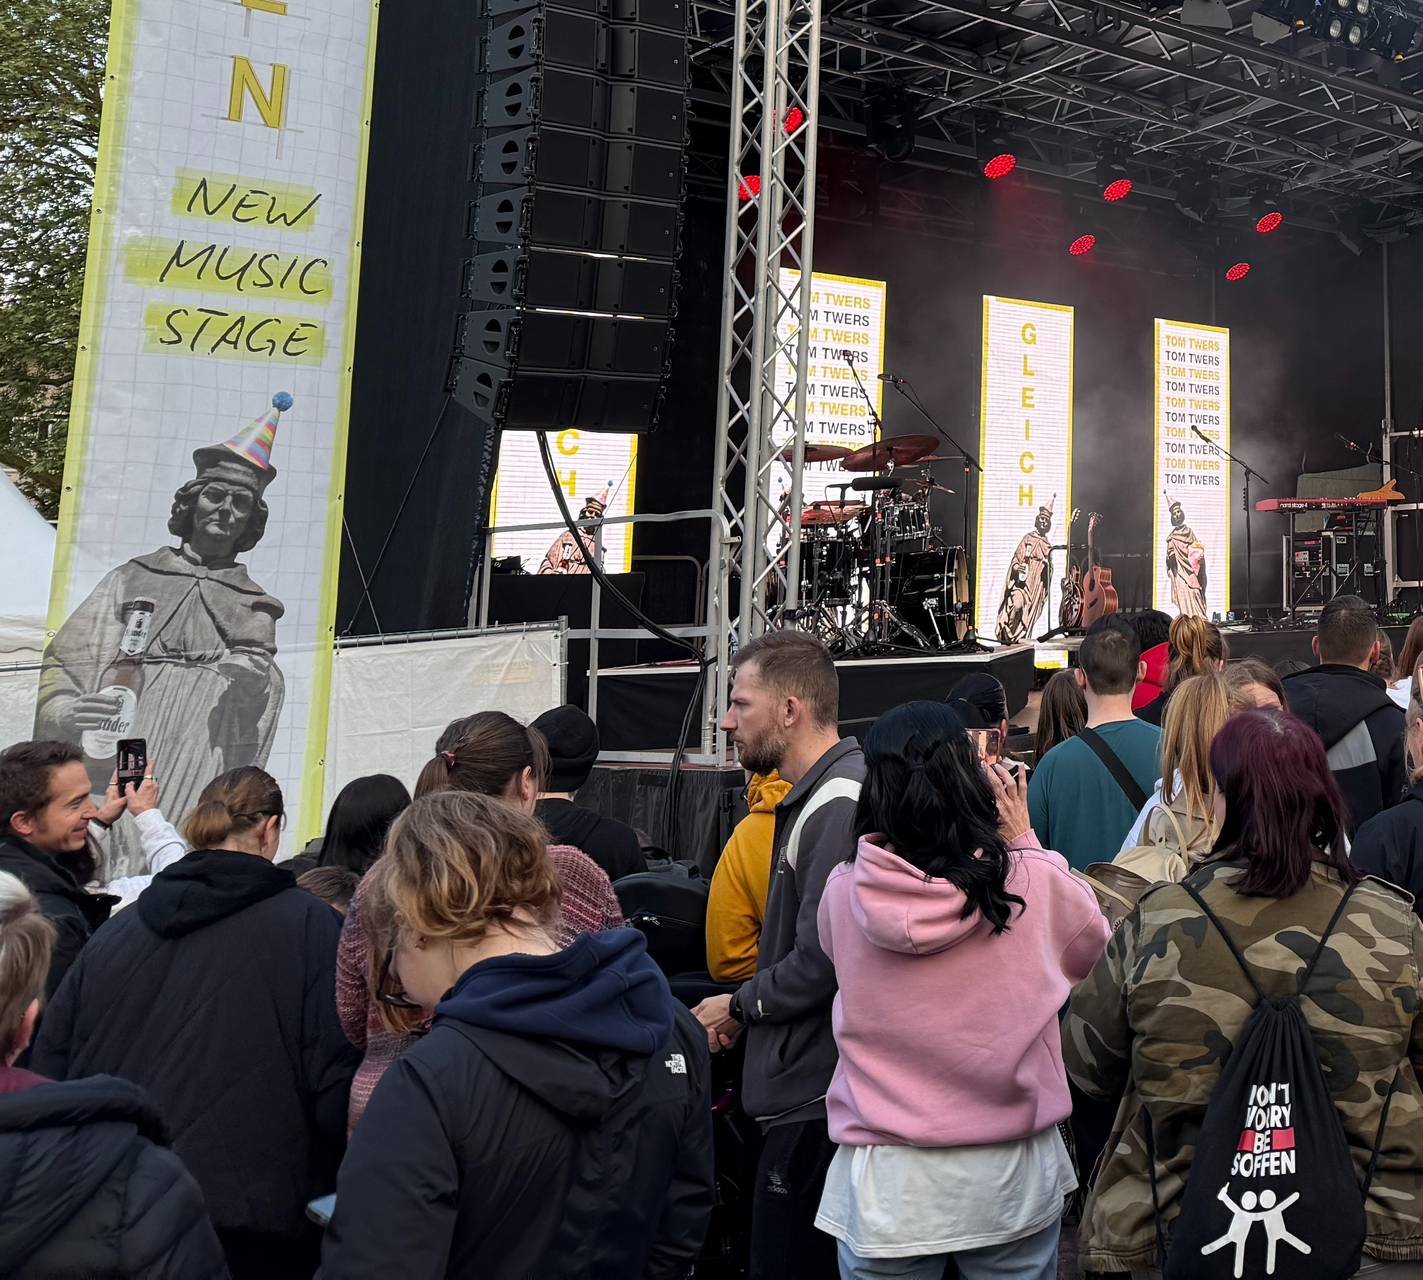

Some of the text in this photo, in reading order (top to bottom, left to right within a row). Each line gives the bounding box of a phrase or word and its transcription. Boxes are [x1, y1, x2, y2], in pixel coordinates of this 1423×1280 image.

[187, 177, 322, 226] NEW
[158, 240, 328, 295] MUSIC
[824, 291, 871, 309] TWERS
[823, 311, 870, 327] TWERS
[160, 308, 318, 356] STAGE
[822, 328, 869, 345] TWERS
[1165, 336, 1220, 352] TOM TWERS
[1165, 351, 1220, 366] TOM TWERS
[1165, 366, 1220, 381] TOM TWERS
[1165, 381, 1220, 396] TOM TWERS
[819, 402, 866, 417] TWERS
[1165, 397, 1220, 411] TOM TWERS
[1018, 323, 1037, 507] GLEICH
[1165, 412, 1220, 425] TOM TWERS
[818, 421, 866, 436] TWERS
[1165, 442, 1220, 456] TOM TWERS
[1165, 458, 1220, 470] TOM TWERS
[1165, 474, 1220, 485] TOM TWERS
[1253, 1129, 1271, 1154] BE
[1230, 1149, 1296, 1178] SOFFEN
